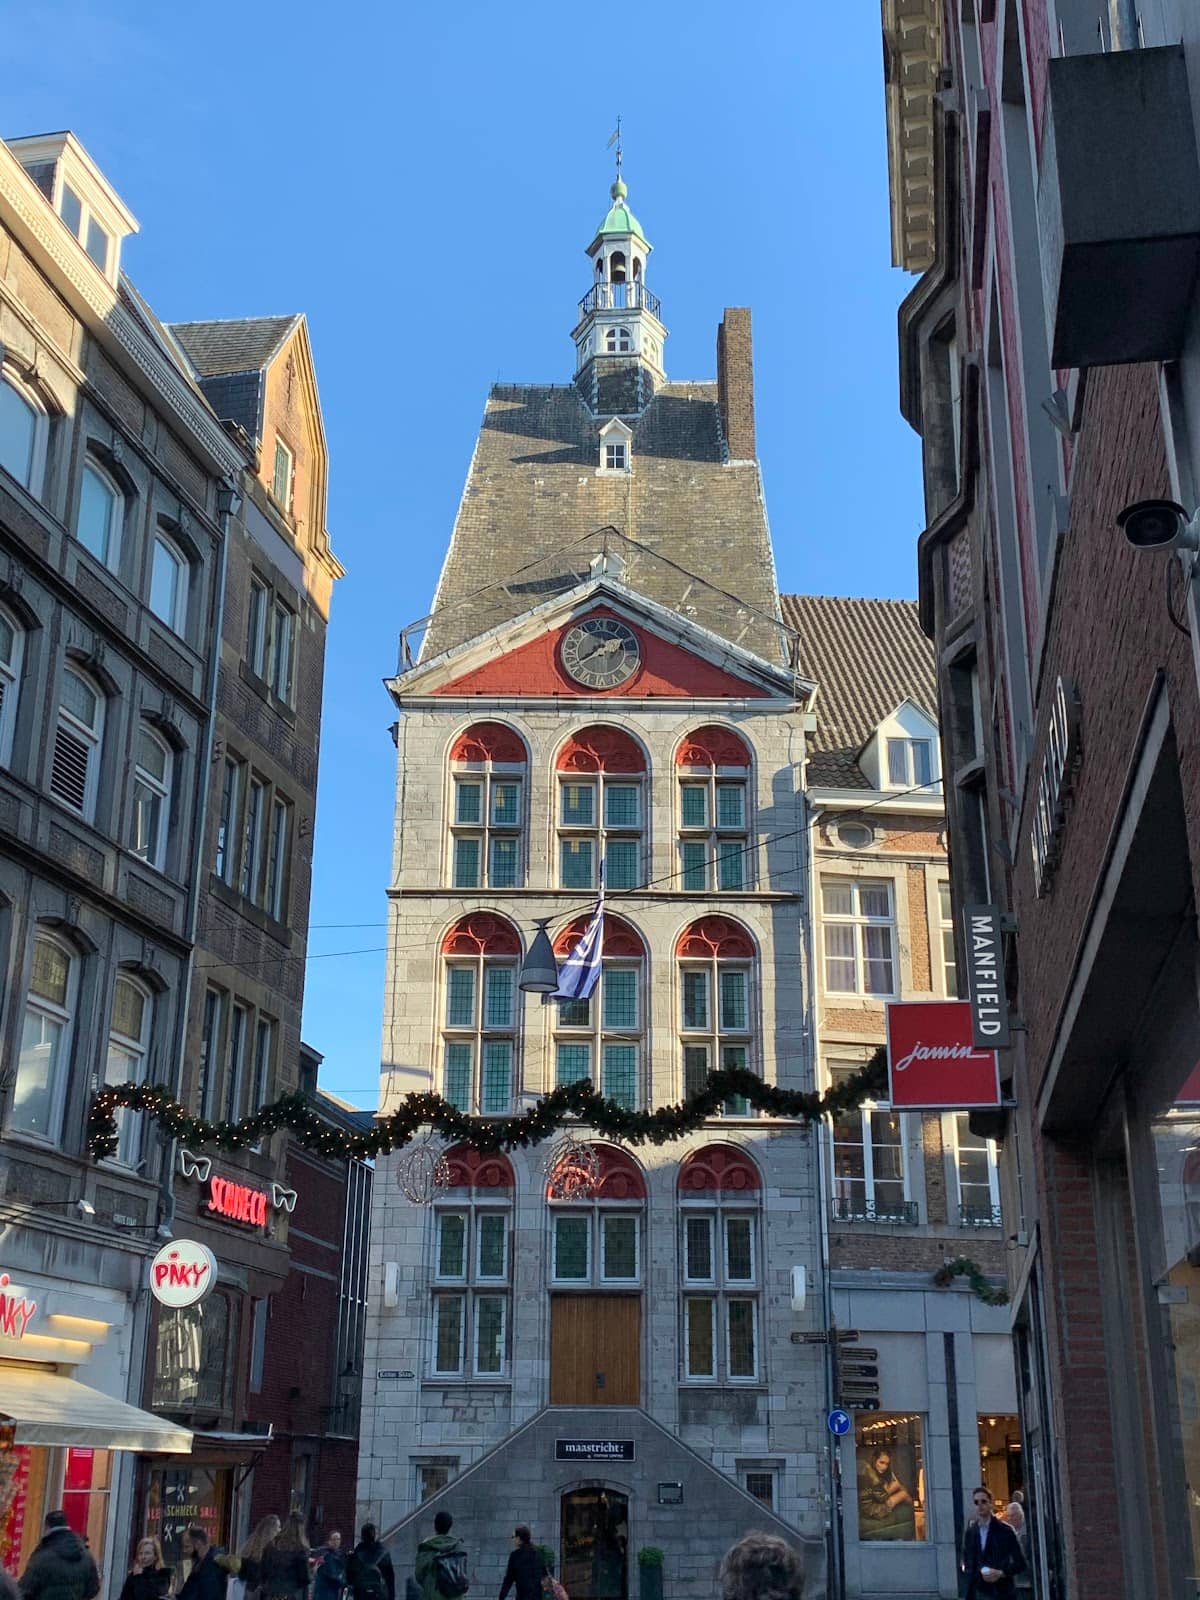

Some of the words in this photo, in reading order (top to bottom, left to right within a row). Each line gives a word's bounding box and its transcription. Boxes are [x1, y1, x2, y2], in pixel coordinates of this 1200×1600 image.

[971, 915, 1001, 1036] MANFIELD
[895, 1041, 990, 1072] jamin
[208, 1175, 267, 1227] SCHMECK
